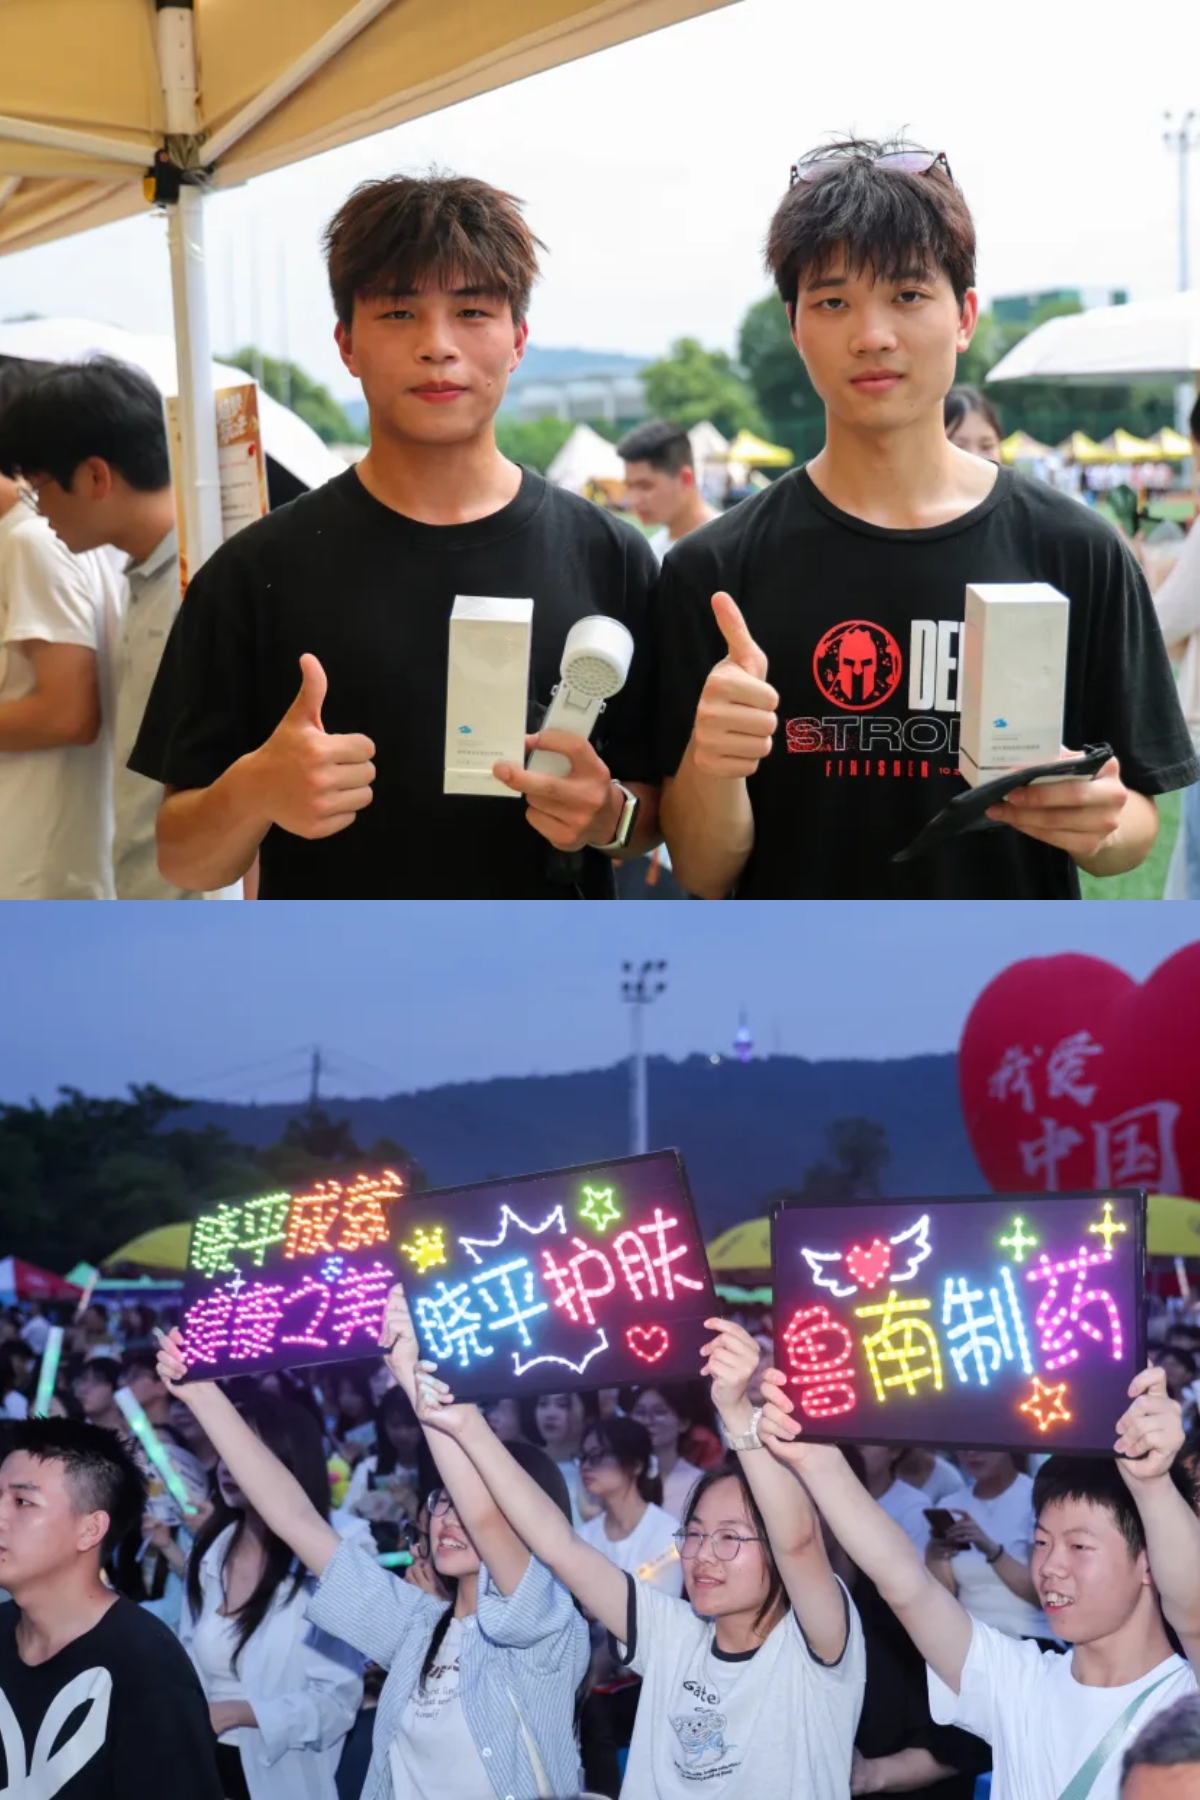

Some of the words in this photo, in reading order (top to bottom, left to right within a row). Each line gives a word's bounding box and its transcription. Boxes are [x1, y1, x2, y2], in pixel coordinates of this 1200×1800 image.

[908, 619, 966, 712] DE
[825, 760, 929, 778] FINISHER
[988, 1031, 1104, 1113] 我爱
[1018, 1100, 1183, 1192] 中国
[181, 1261, 395, 1365] 健康之美
[416, 1208, 705, 1367] 晓平护肤
[783, 1246, 1124, 1418] 鲁南制药
